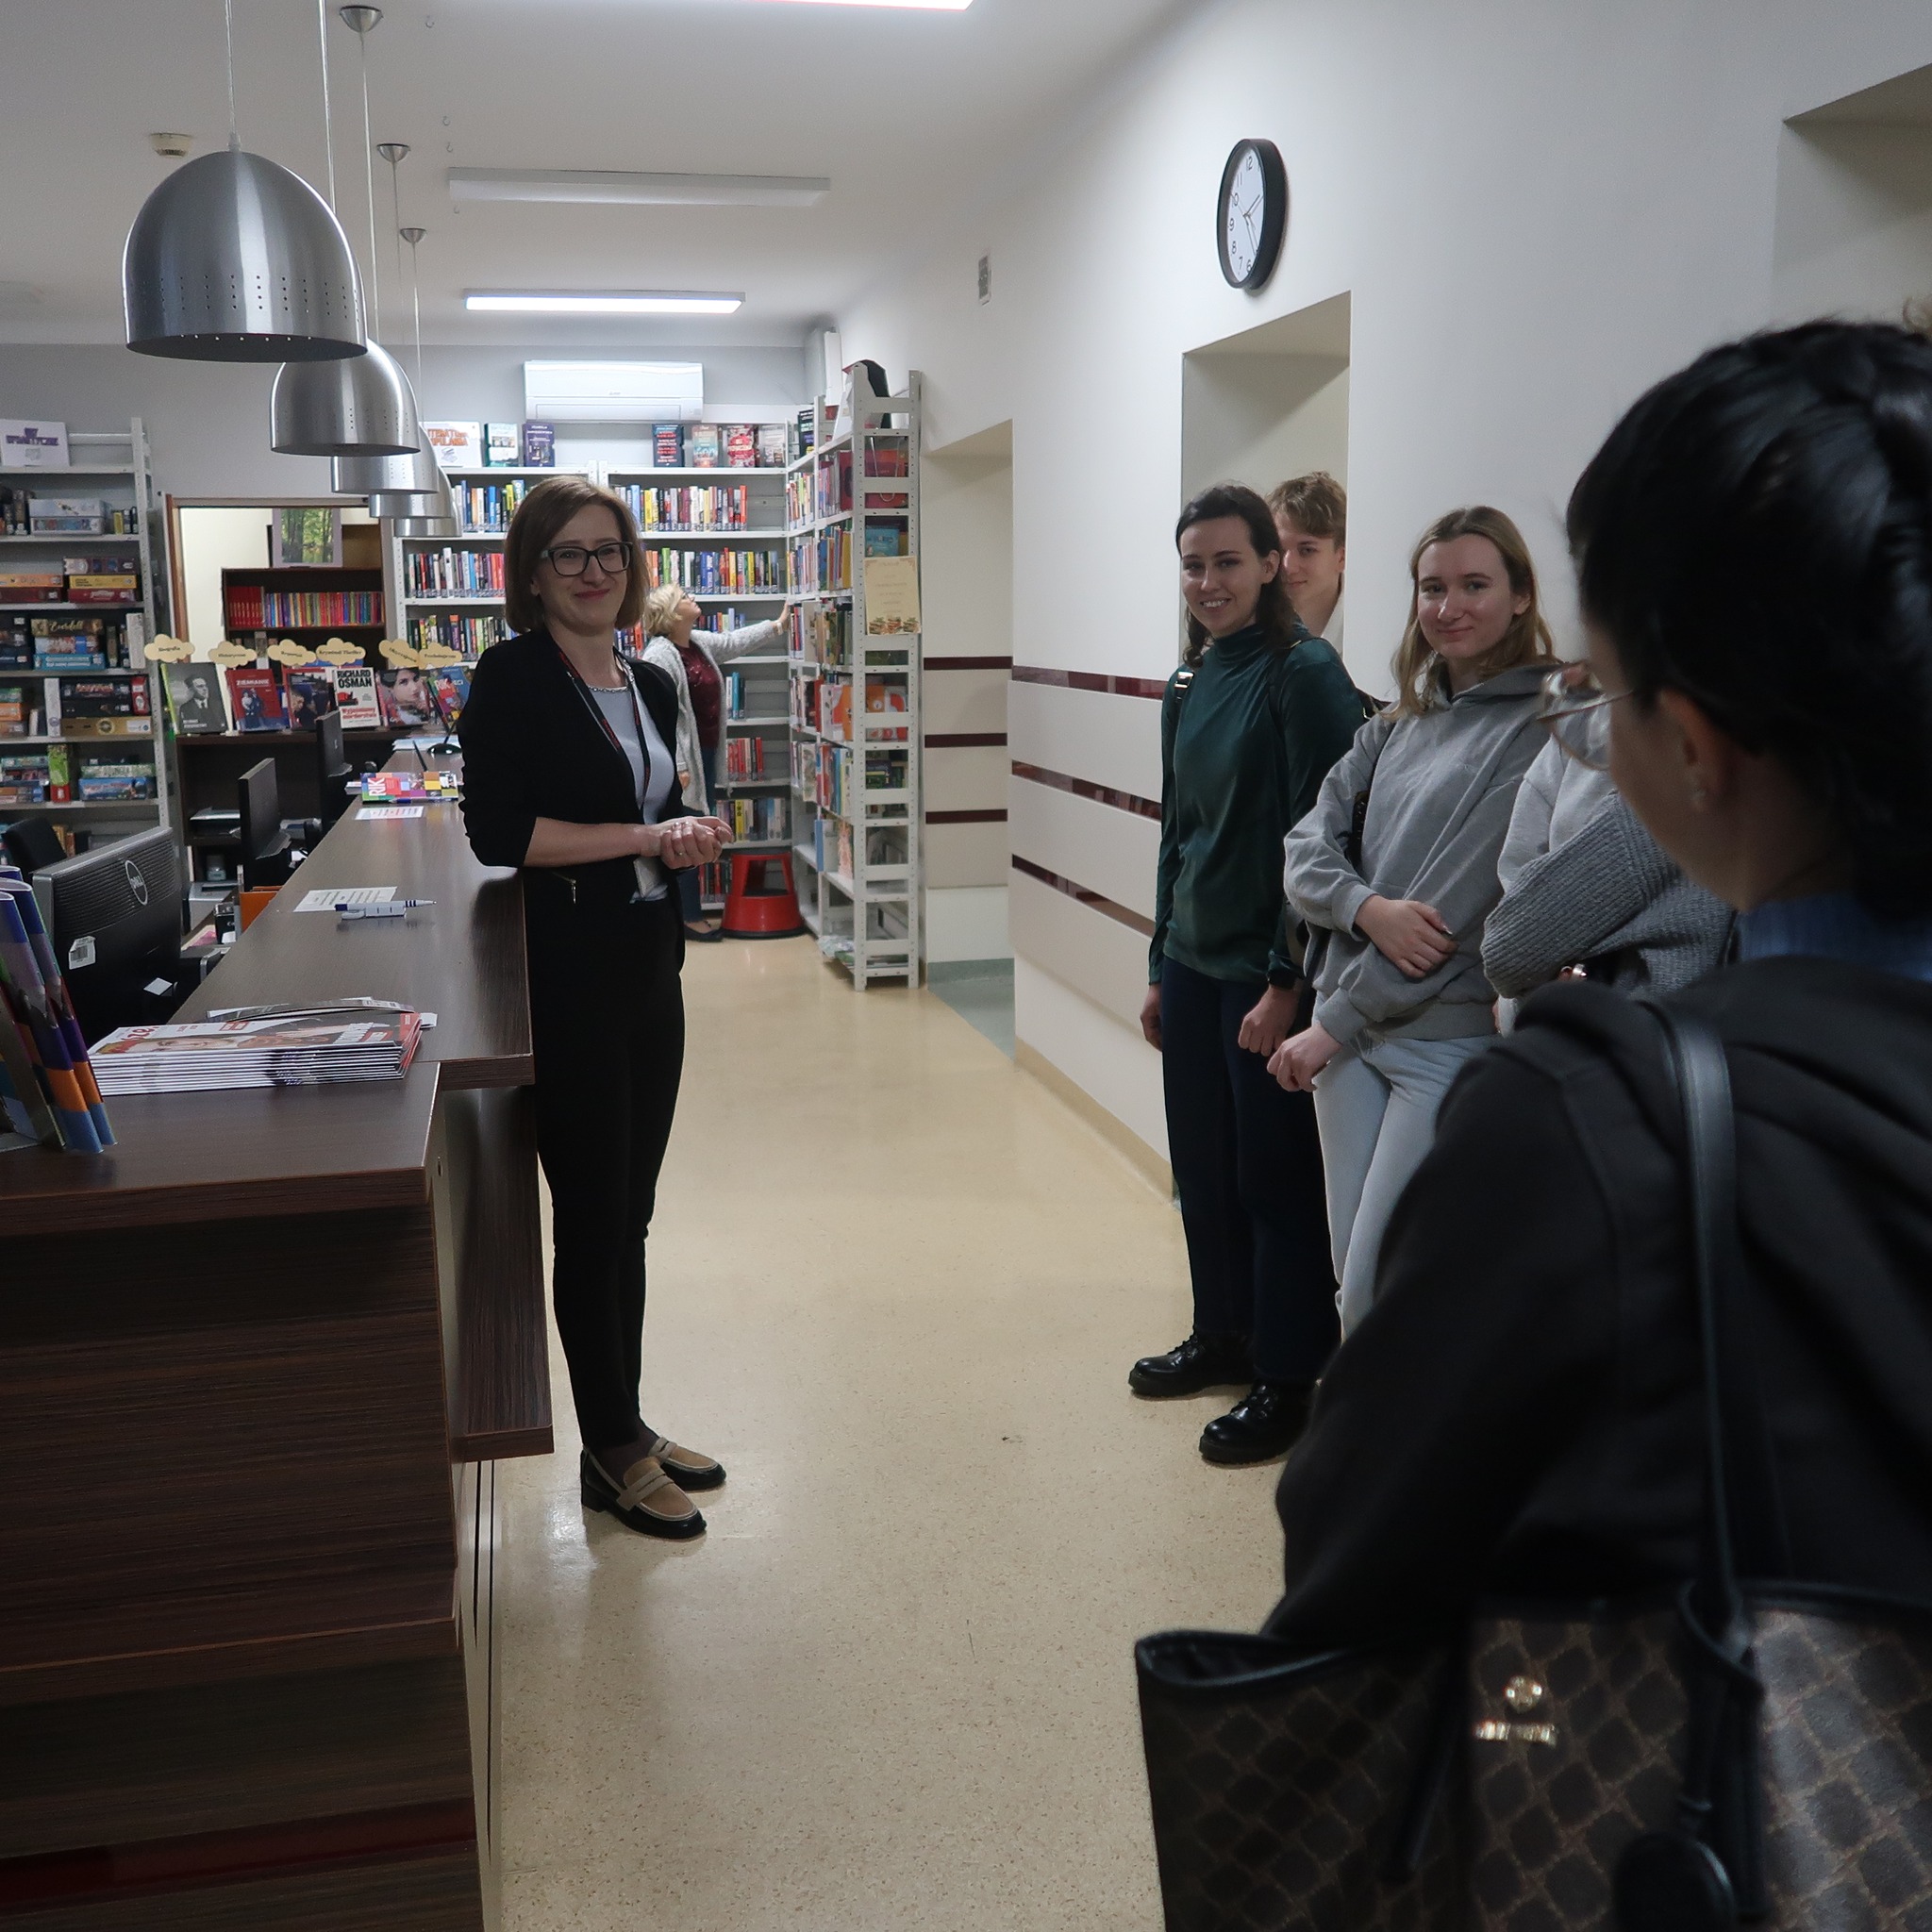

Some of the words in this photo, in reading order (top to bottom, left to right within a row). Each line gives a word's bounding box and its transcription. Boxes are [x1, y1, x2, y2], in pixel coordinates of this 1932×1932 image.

[1244, 156, 1253, 171] 12
[1236, 173, 1243, 187] 11
[1230, 192, 1240, 208] 10
[1228, 217, 1235, 232] 9
[1231, 241, 1237, 255] 8
[1238, 256, 1244, 271] 7
[337, 670, 372, 679] RICHARD
[338, 677, 373, 689] OSMAN
[367, 777, 387, 796] RIK
